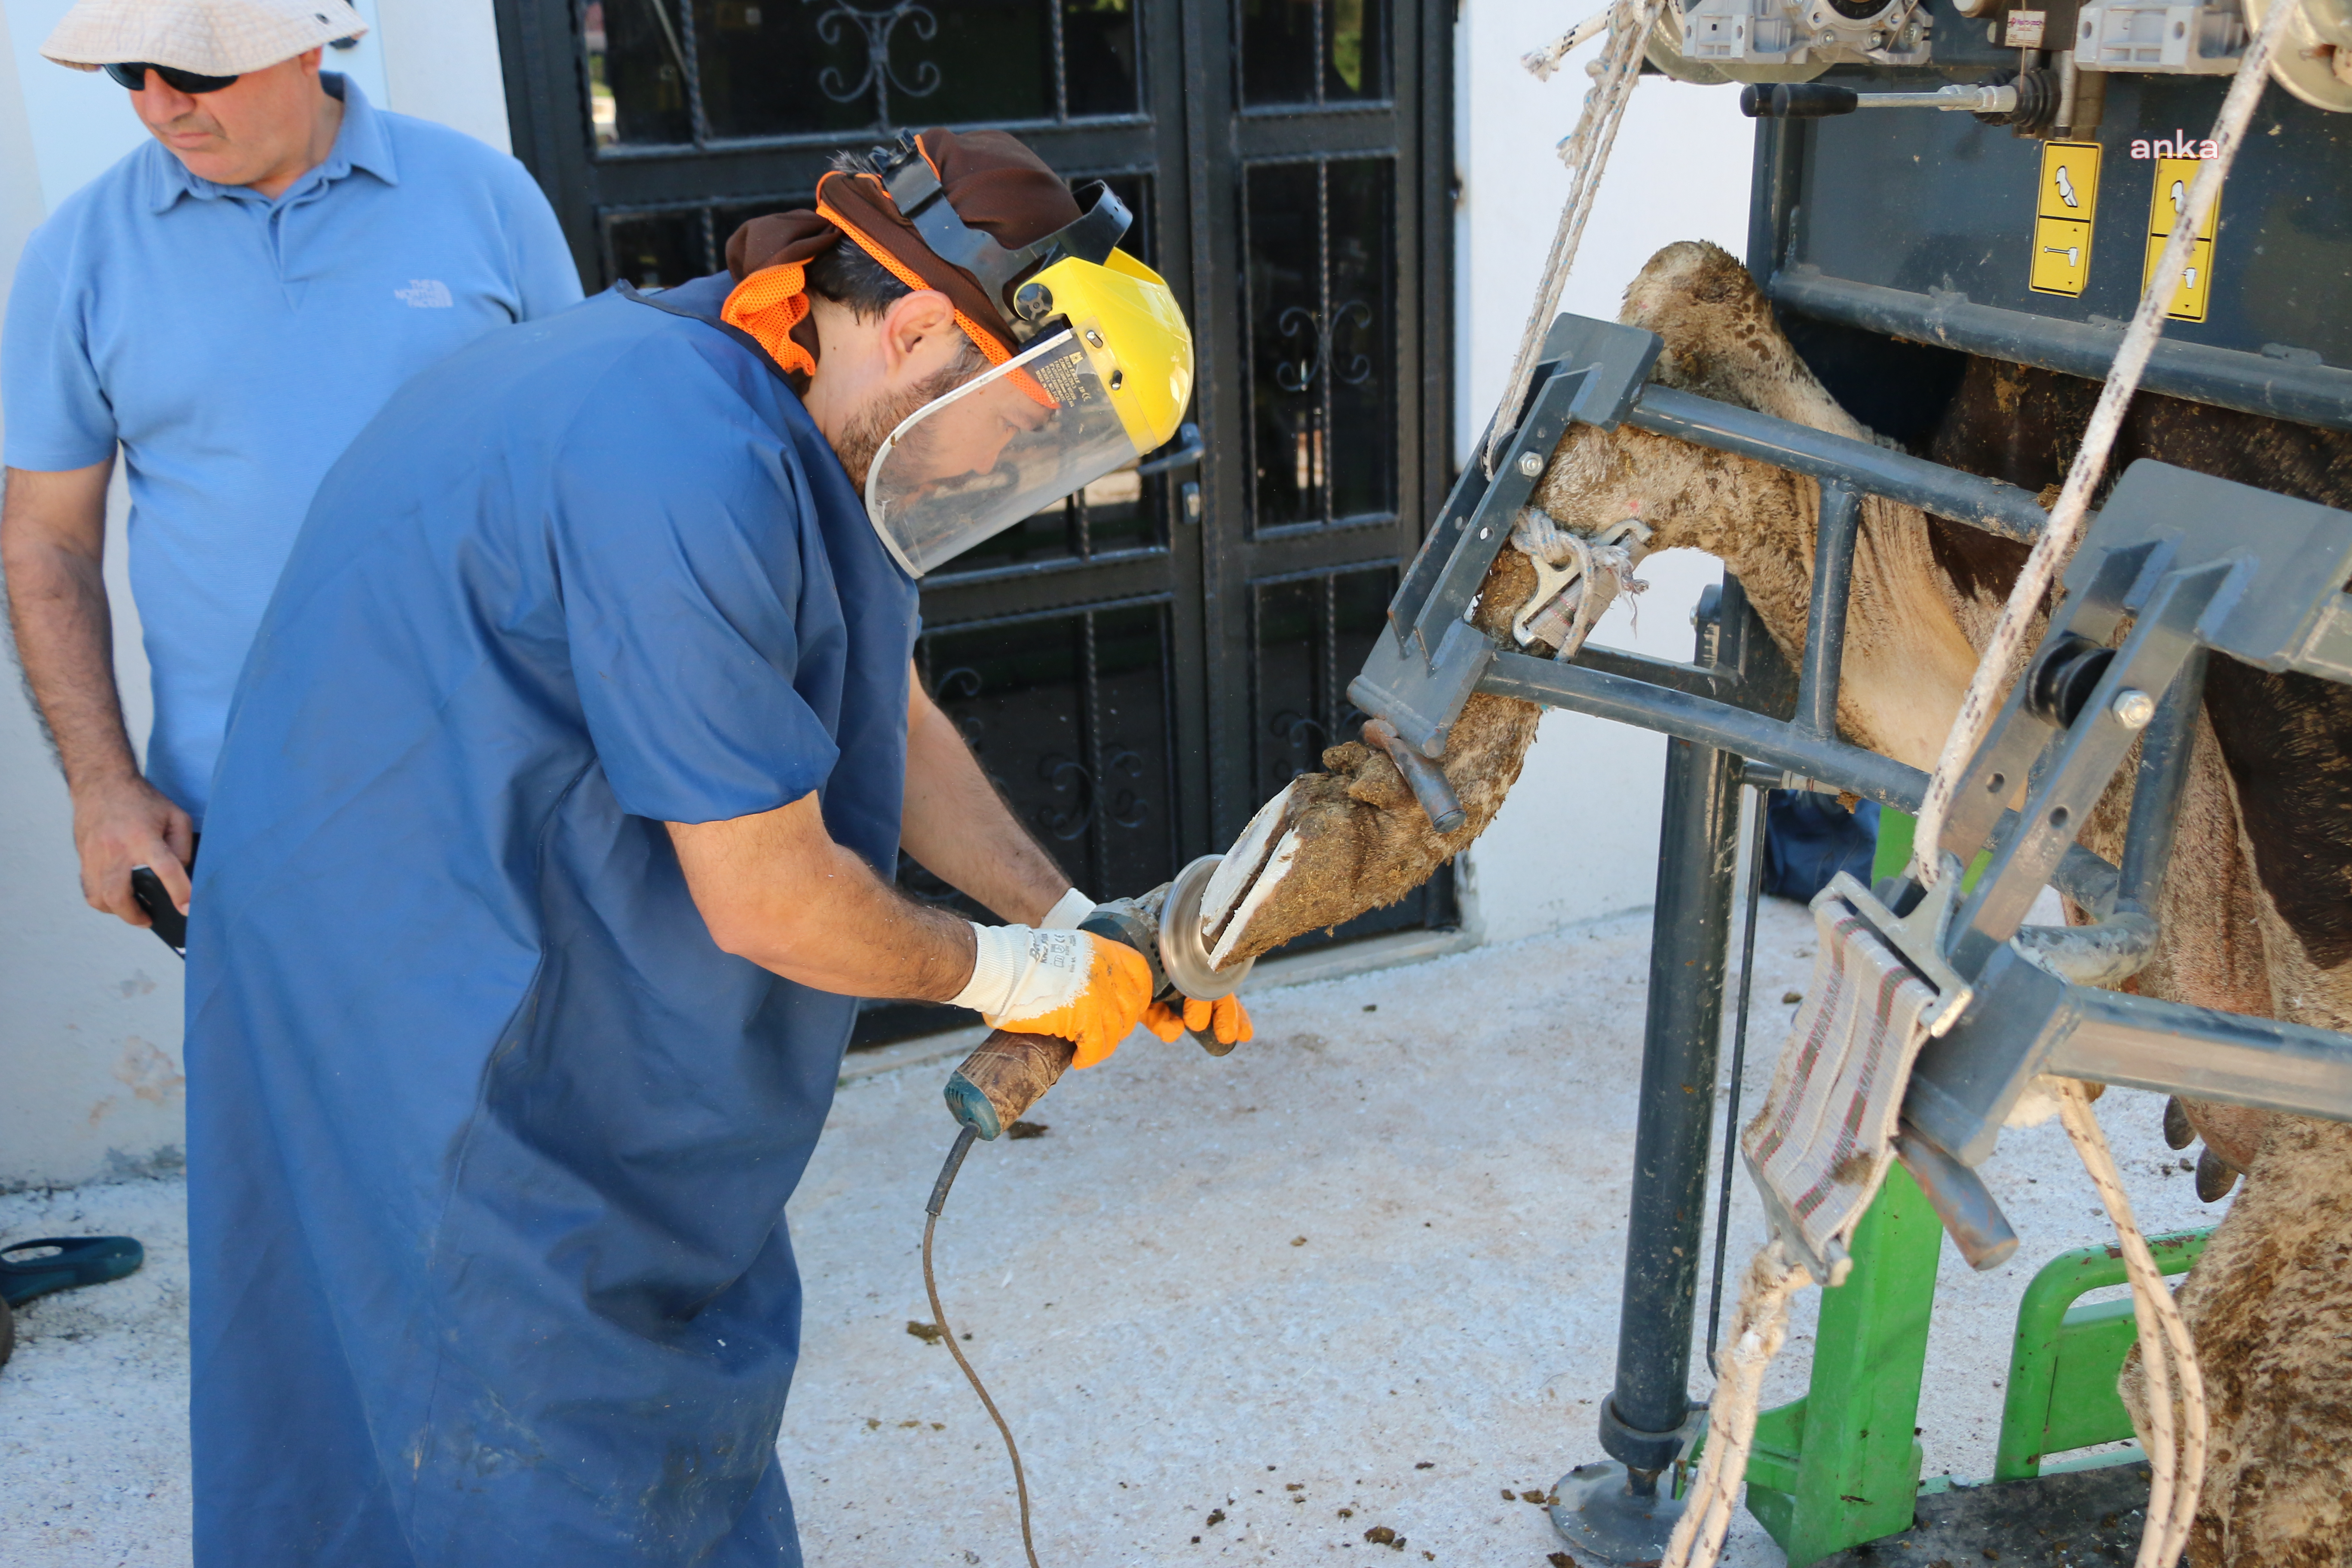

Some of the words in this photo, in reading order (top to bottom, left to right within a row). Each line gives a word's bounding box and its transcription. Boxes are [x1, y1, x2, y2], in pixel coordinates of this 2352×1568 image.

[410, 279, 430, 289] THE
[1040, 368, 1050, 383] MODEL
[1035, 370, 1044, 383] MADE
[1044, 387, 1055, 404] TAIWAN
[1044, 365, 1066, 402] POLYCARBONATE
[1064, 392, 1075, 407] CLEAR
[1067, 386, 1077, 400] VISOR
